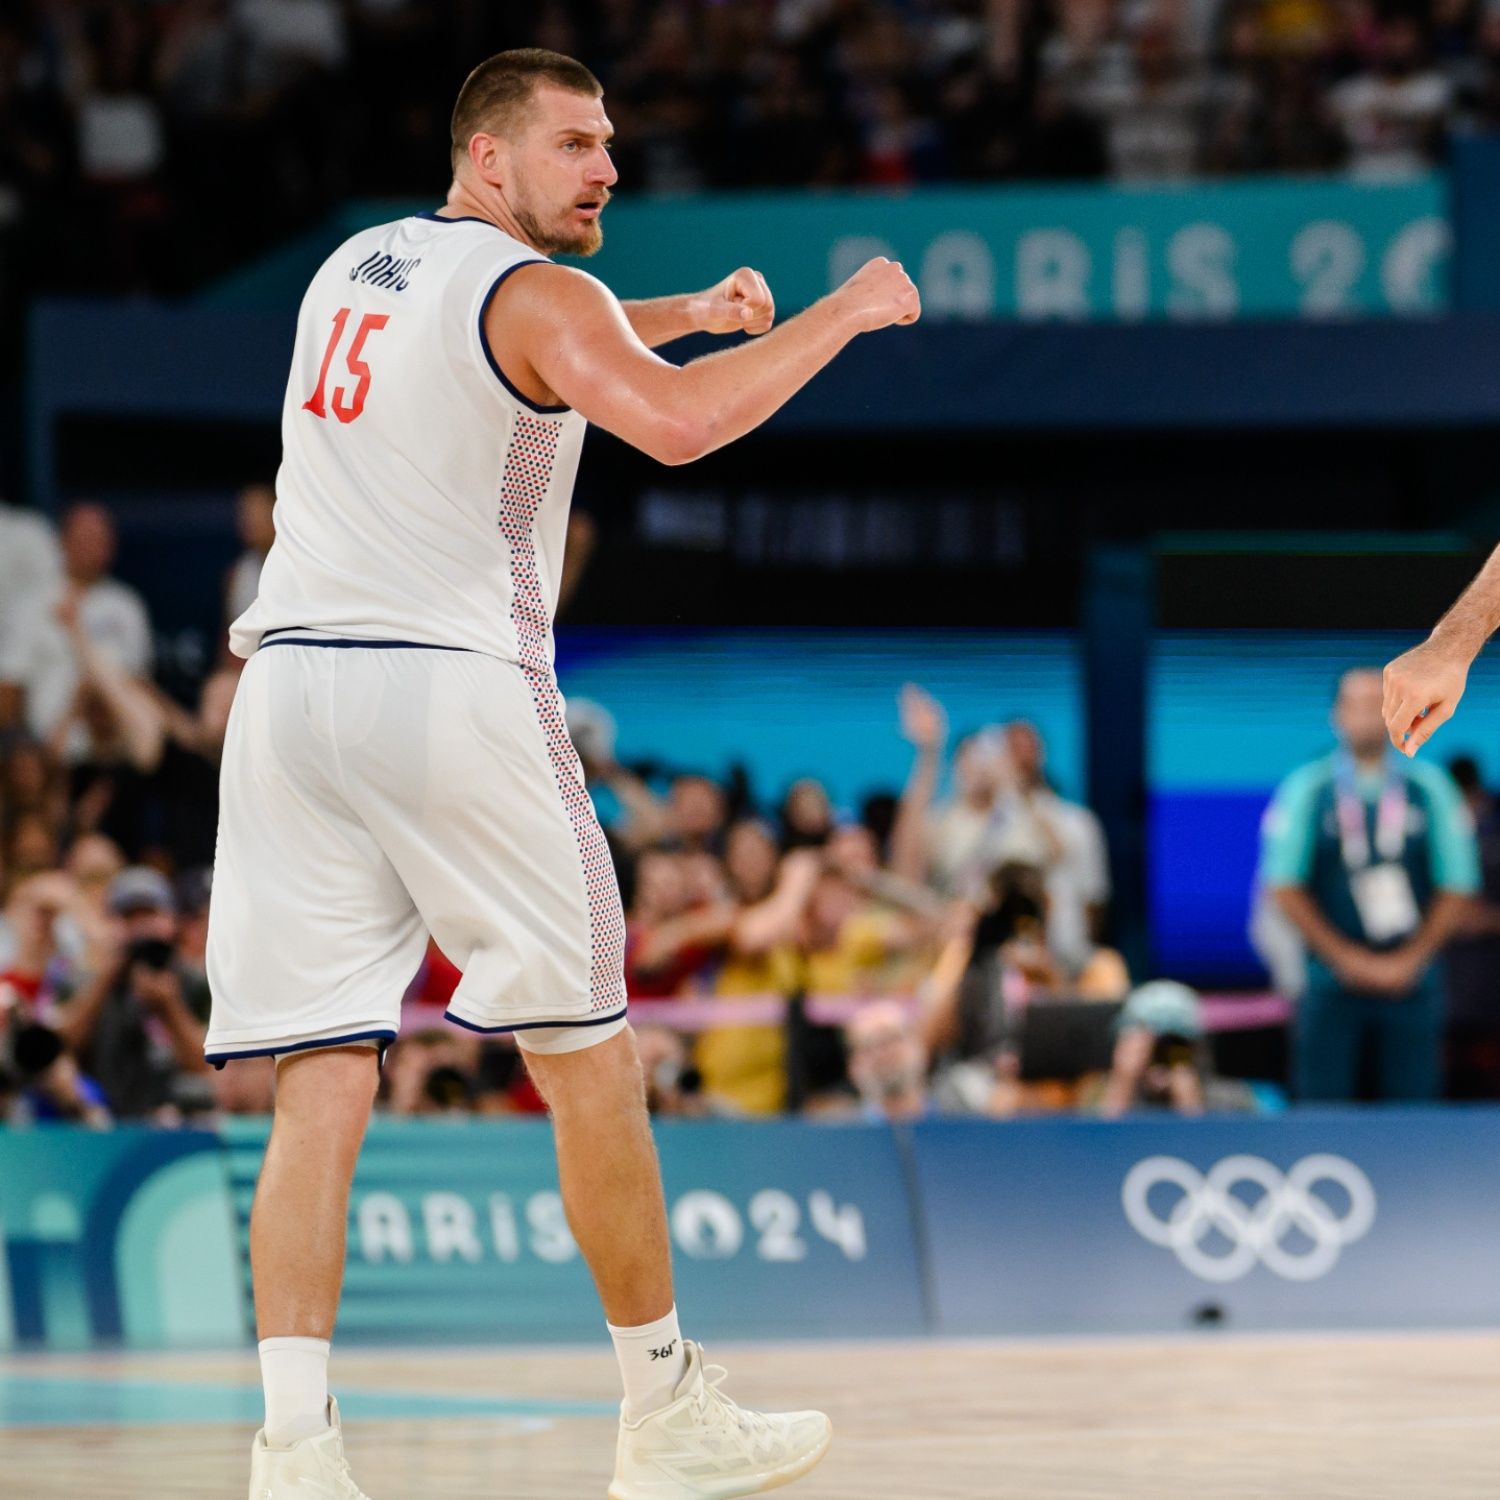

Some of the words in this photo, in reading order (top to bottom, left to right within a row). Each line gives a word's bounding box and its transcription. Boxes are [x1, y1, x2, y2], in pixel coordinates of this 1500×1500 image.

[302, 307, 390, 424] 15
[358, 1190, 580, 1264] ARIS
[671, 1188, 867, 1262] 024
